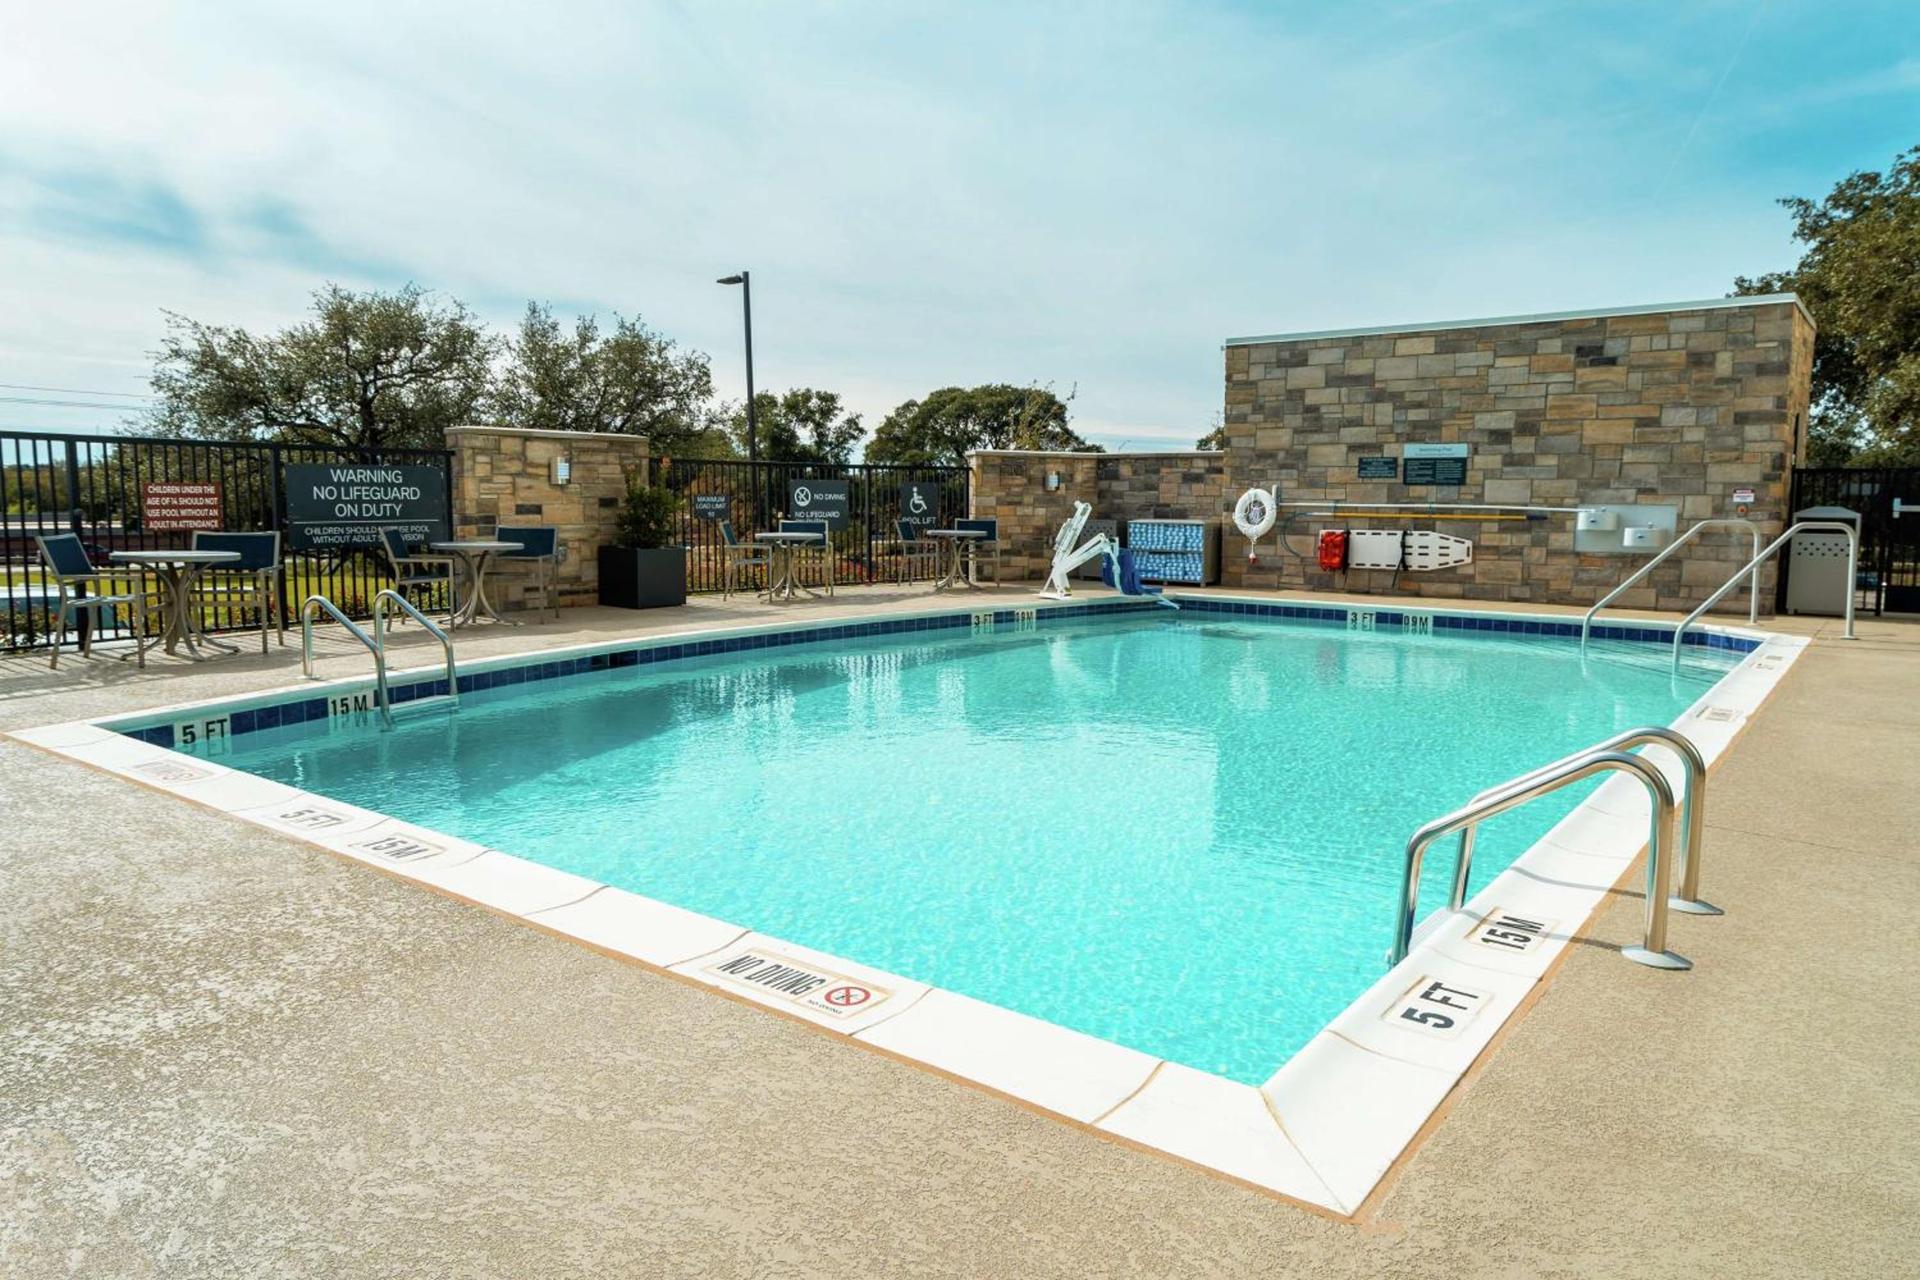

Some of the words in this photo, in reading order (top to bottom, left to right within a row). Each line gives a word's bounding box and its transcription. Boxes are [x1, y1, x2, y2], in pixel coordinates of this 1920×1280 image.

[330, 468, 403, 484] WARNING
[147, 485, 180, 494] CHILDREN
[181, 485, 203, 494] UNDER
[203, 485, 215, 494] THE
[313, 486, 338, 500] NO
[341, 486, 421, 500] LIFEGUARD
[146, 497, 160, 505] AGE
[161, 497, 171, 505] OF
[178, 497, 204, 505] SHOULD
[204, 497, 218, 505] NOT
[147, 508, 160, 517] USE
[161, 508, 179, 517] POOL
[179, 508, 209, 517] WITHOUT
[209, 508, 219, 516] AN
[335, 503, 359, 517] ON
[362, 503, 402, 517] DUTY
[149, 520, 171, 529] ADULT
[171, 520, 177, 528] IN
[178, 520, 219, 529] ATTENDANCE
[922, 516, 937, 524] LIFT
[304, 526, 344, 536] CHILDREN
[345, 526, 378, 535] SHOULD
[410, 525, 430, 533] POOL
[312, 535, 350, 544] WITHOUT
[352, 534, 377, 543] ADULT
[974, 615, 980, 626] 3
[983, 613, 993, 624] FT
[1351, 611, 1358, 622] 3
[1362, 612, 1374, 622] FT
[182, 724, 197, 744] 5
[205, 718, 228, 740] FT
[280, 809, 316, 819] 5
[716, 955, 765, 975] NO
[744, 964, 826, 996] DIVING
[1420, 981, 1479, 1011] FT
[1401, 1007, 1455, 1029] 5
